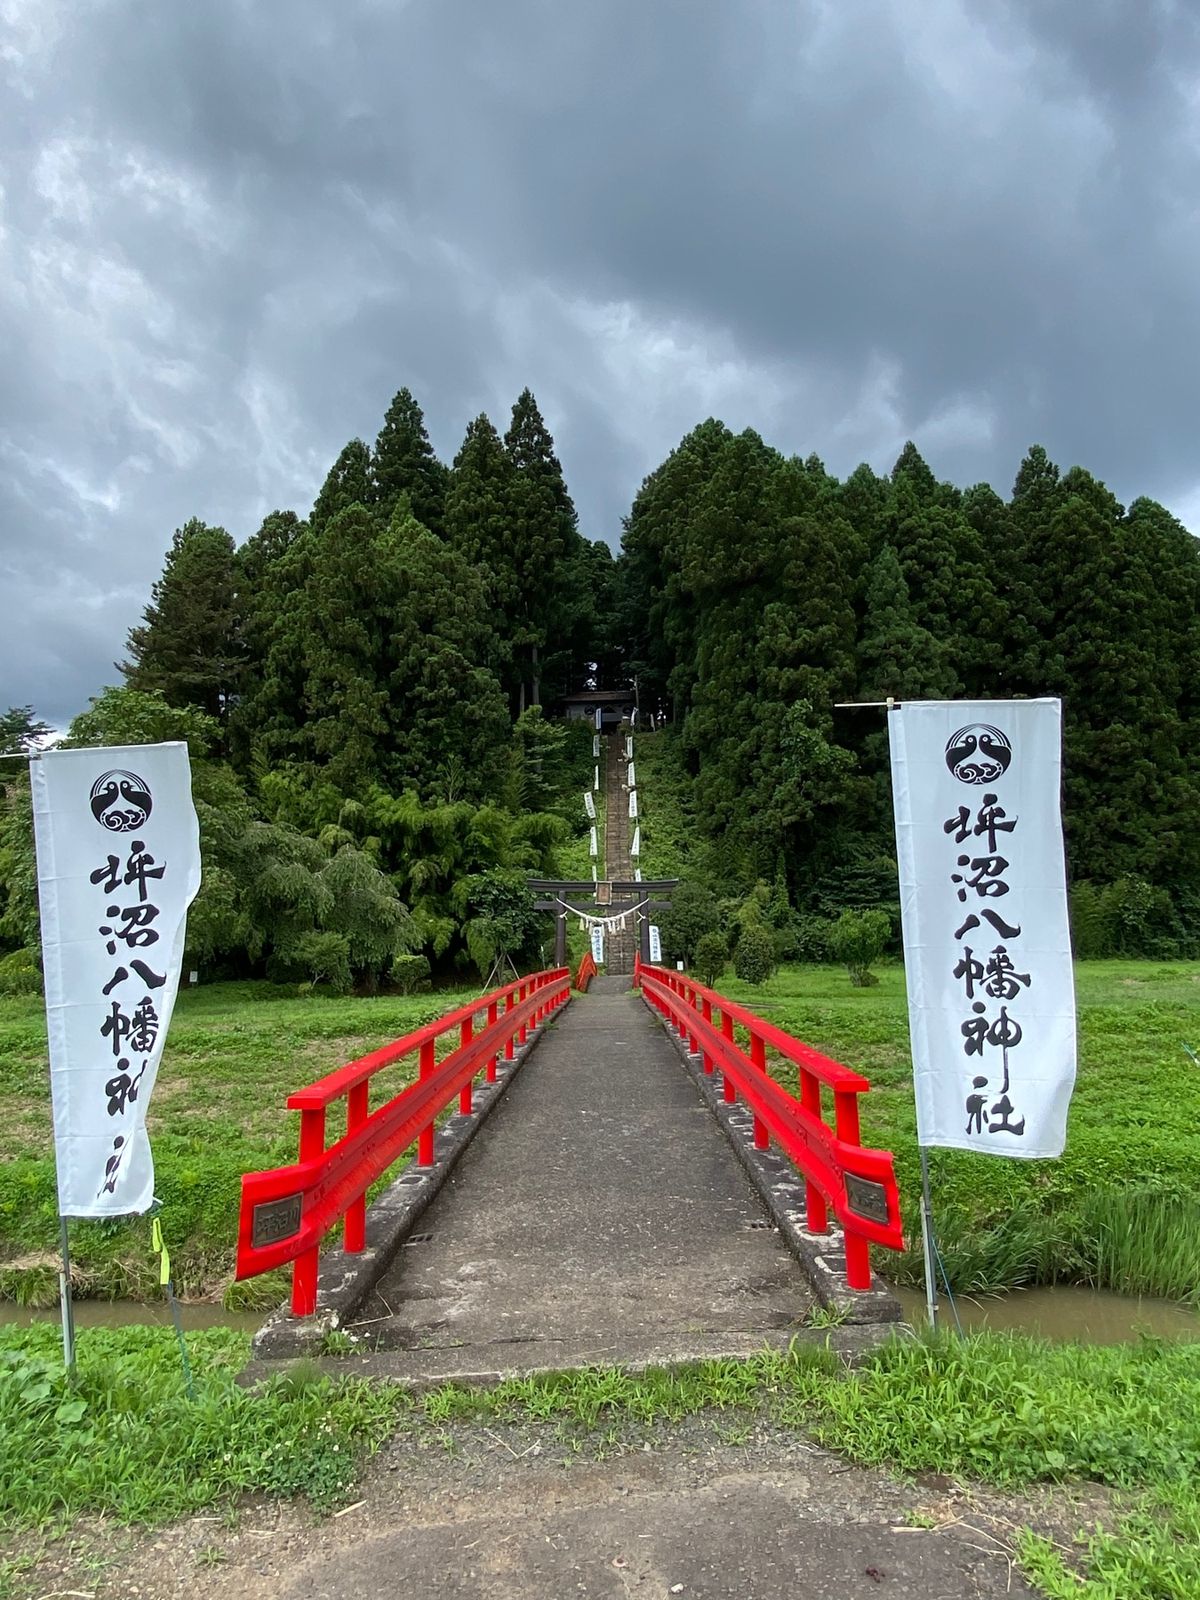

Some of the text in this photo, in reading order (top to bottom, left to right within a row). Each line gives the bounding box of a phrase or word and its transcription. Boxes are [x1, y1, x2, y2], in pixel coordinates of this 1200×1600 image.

[943, 794, 1031, 1136] 坪沼八幡神社
